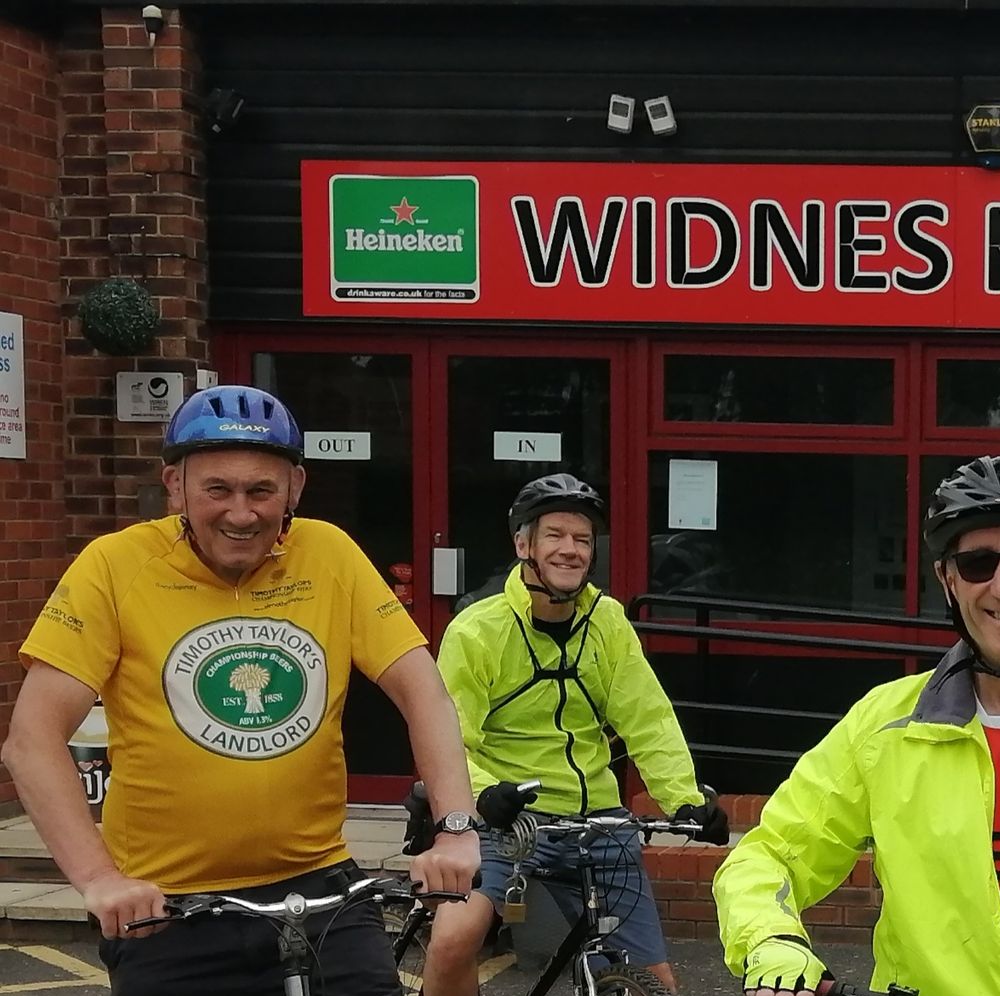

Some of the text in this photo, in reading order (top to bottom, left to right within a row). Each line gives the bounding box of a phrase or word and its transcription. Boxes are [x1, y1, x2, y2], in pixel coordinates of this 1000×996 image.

[345, 228, 464, 252] Heineken
[511, 195, 952, 296] WIDNES
[347, 289, 422, 298] drinkaware.co.uk
[219, 424, 270, 433] GALAXY
[318, 438, 356, 453] OUT
[517, 439, 537, 453] IN
[175, 625, 322, 674] TIMOTHY TAYLOR'S
[206, 650, 294, 678] CHAMPIONSHIP BEERS
[239, 715, 254, 725] ABV
[200, 715, 312, 753] LANDLORD
